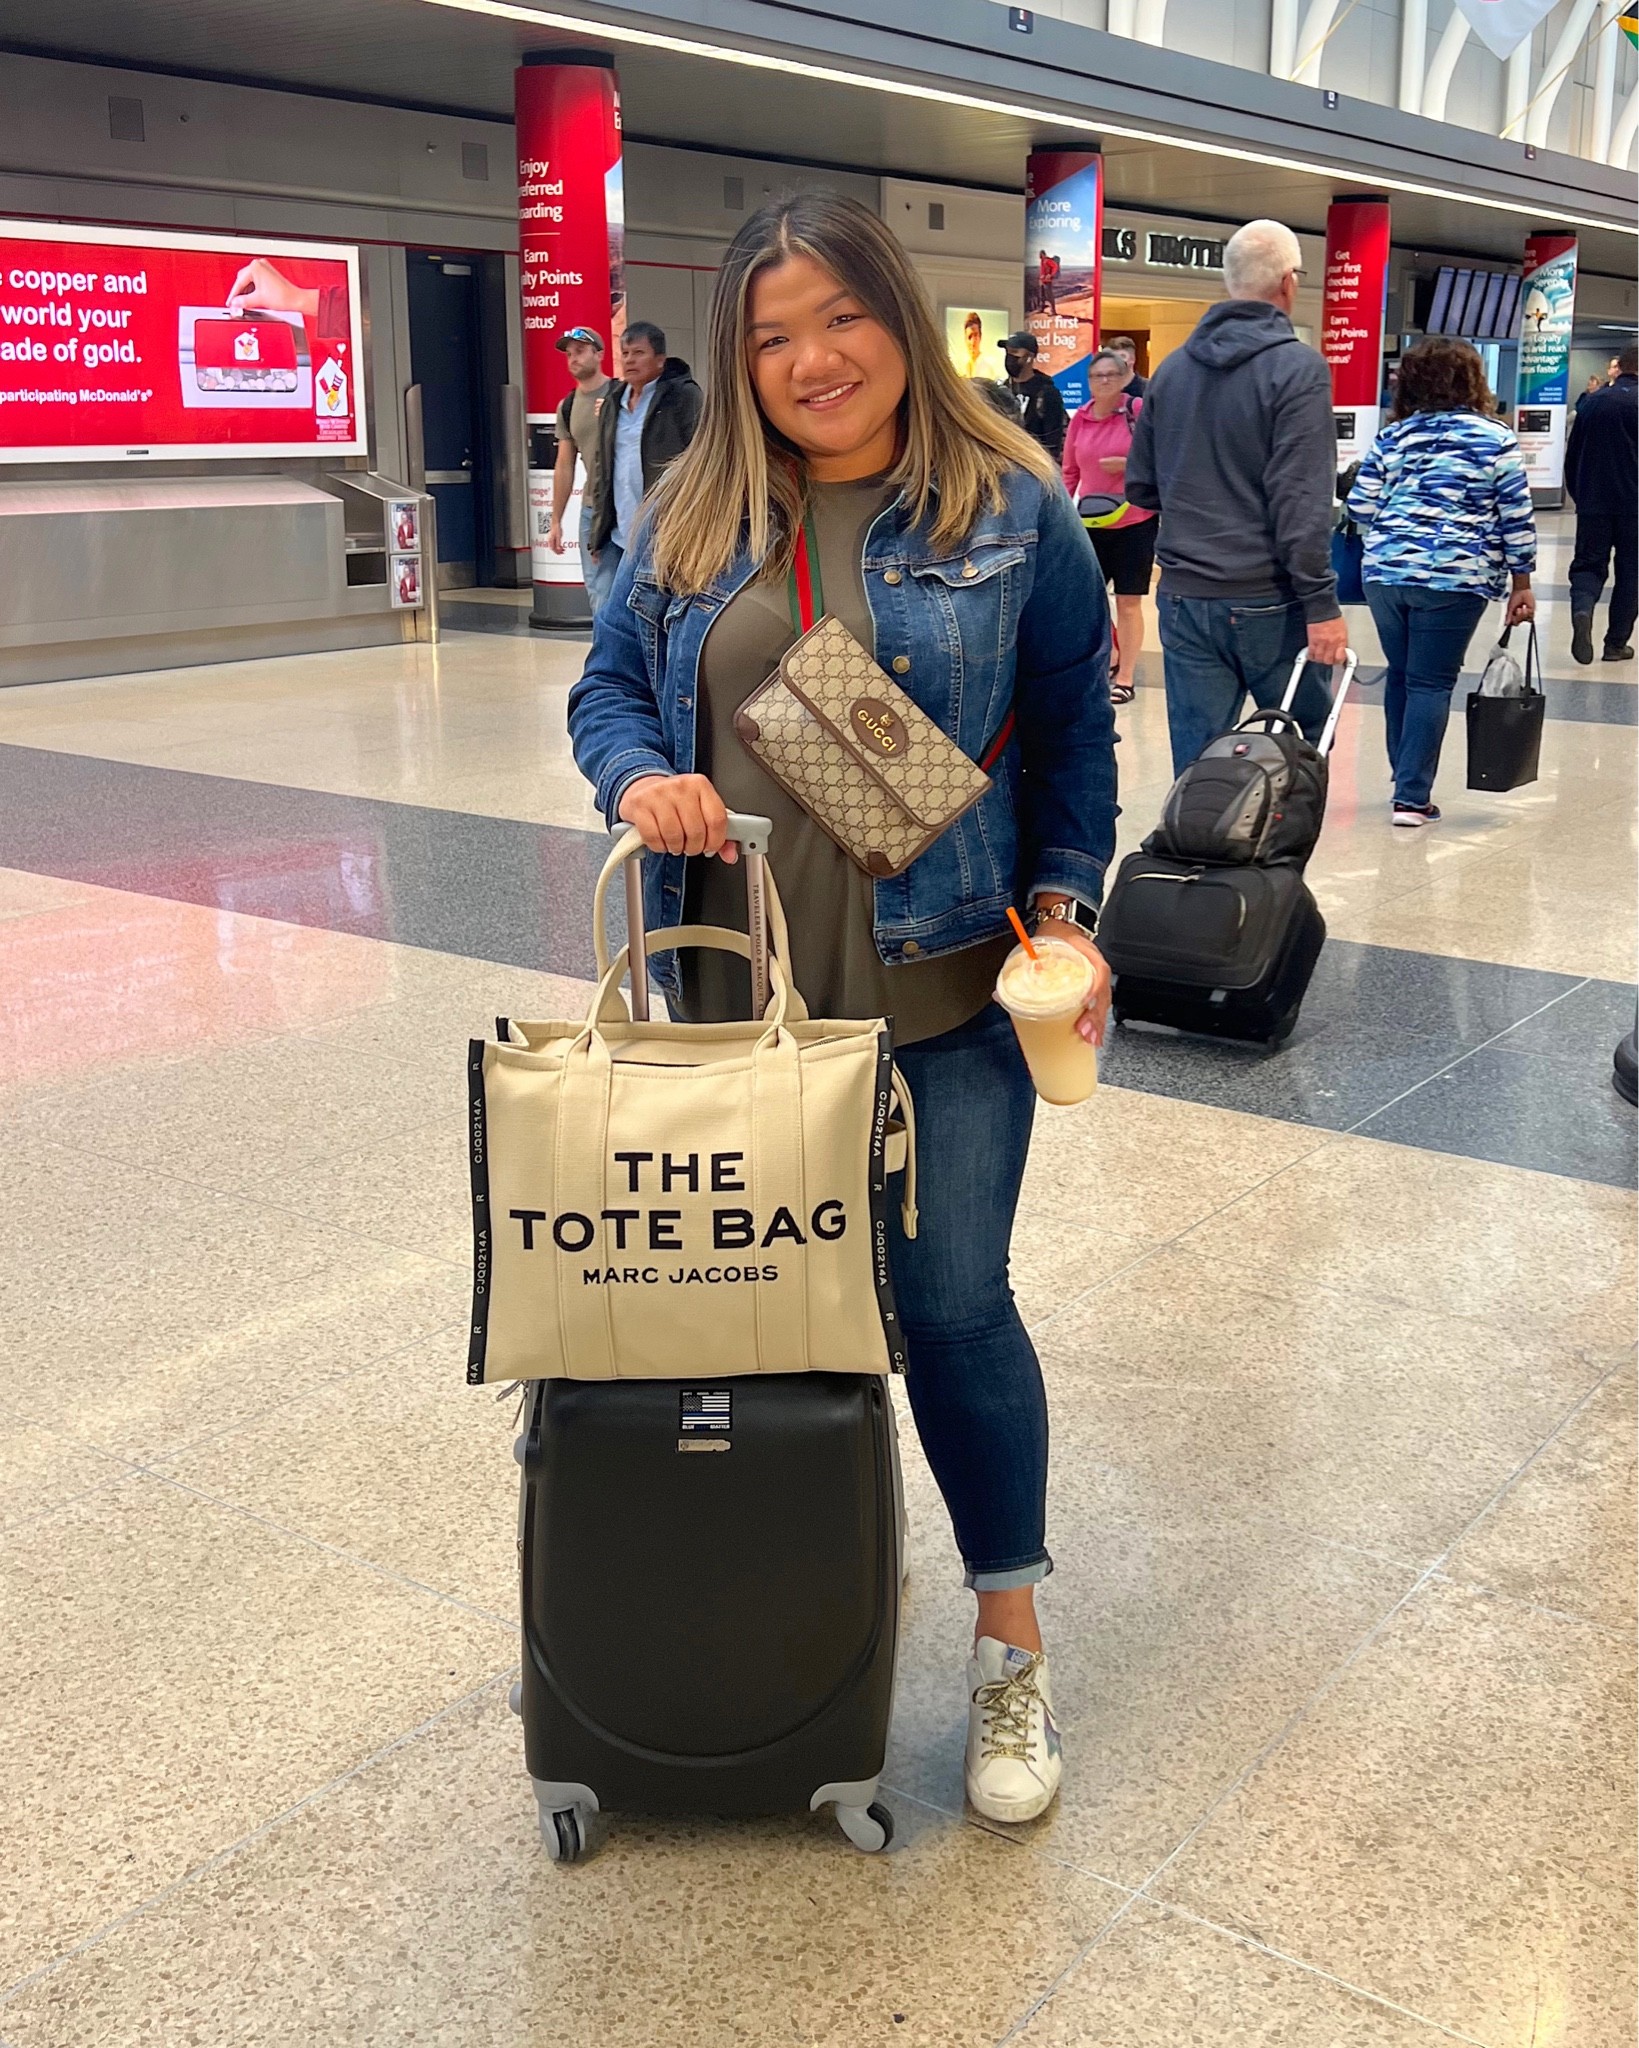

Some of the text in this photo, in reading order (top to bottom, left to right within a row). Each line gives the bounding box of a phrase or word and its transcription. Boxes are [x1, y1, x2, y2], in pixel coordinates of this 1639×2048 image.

[519, 158, 550, 178] Enjoy
[1037, 199, 1072, 213] More
[1029, 214, 1082, 232] Exploring
[524, 248, 549, 263] Earn
[1335, 250, 1350, 260] Get
[1343, 262, 1362, 274] first
[9, 269, 147, 296] copper and
[539, 268, 583, 285] Points
[1340, 289, 1358, 300] free
[0, 302, 132, 333] world your
[1054, 315, 1079, 329] first
[1330, 316, 1350, 325] Earn
[1341, 328, 1368, 338] Points
[1053, 332, 1077, 349] bag
[0, 336, 142, 368] ade of gold.
[1548, 344, 1567, 353] reach
[0, 389, 77, 405] participating
[856, 709, 897, 752] GUCCI
[753, 883, 761, 931] TRAVELERS
[882, 1053, 891, 1061] R
[473, 1062, 480, 1070] R
[614, 1152, 745, 1192] THE
[873, 1183, 882, 1192] R
[475, 1194, 485, 1202] R
[509, 1199, 847, 1252] TOTE BAG
[583, 1265, 779, 1285] MARC JACOBS
[885, 1312, 895, 1321] R
[473, 1325, 482, 1334] R
